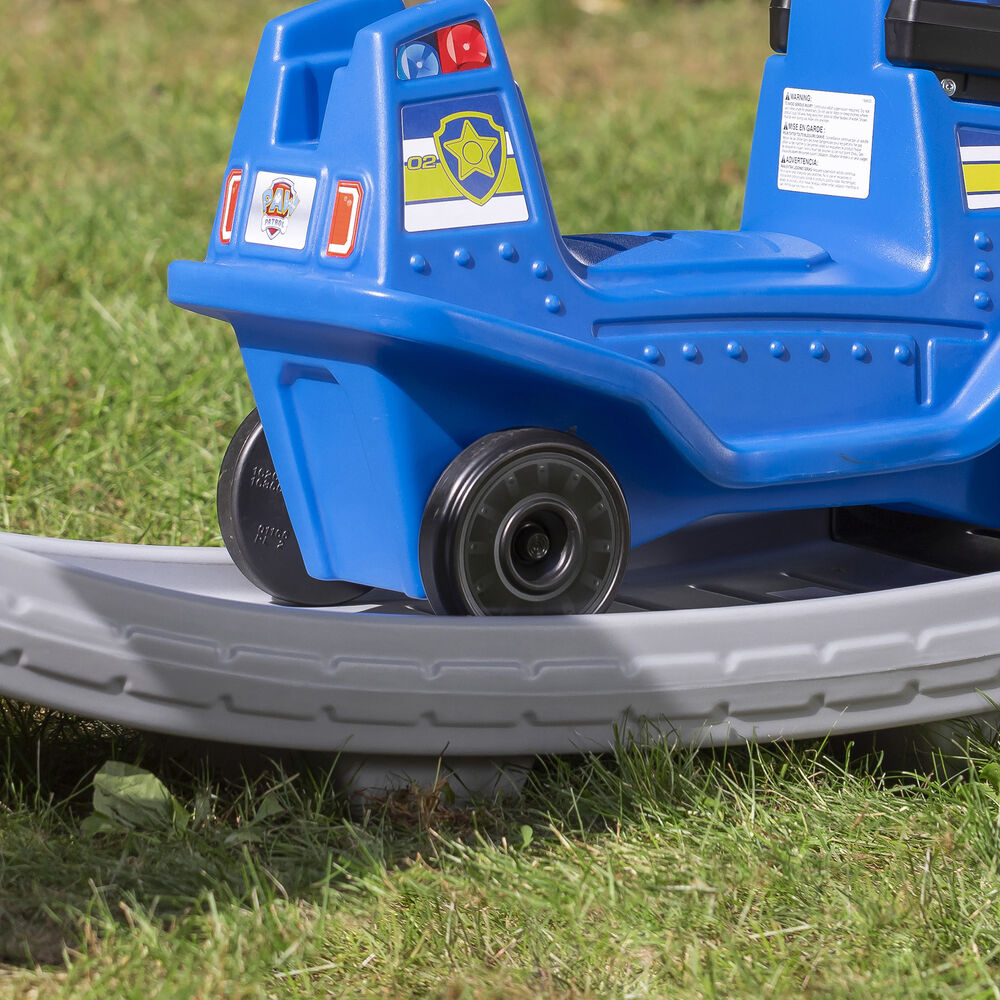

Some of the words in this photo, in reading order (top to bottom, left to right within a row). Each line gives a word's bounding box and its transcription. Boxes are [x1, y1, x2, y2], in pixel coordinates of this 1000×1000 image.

[790, 93, 813, 102] WARNING:
[788, 122, 799, 131] MISE
[799, 124, 806, 132] EN
[806, 125, 824, 133] GARDE
[407, 154, 437, 171] 02
[261, 187, 300, 218] PAW
[265, 218, 285, 229] PATROL
